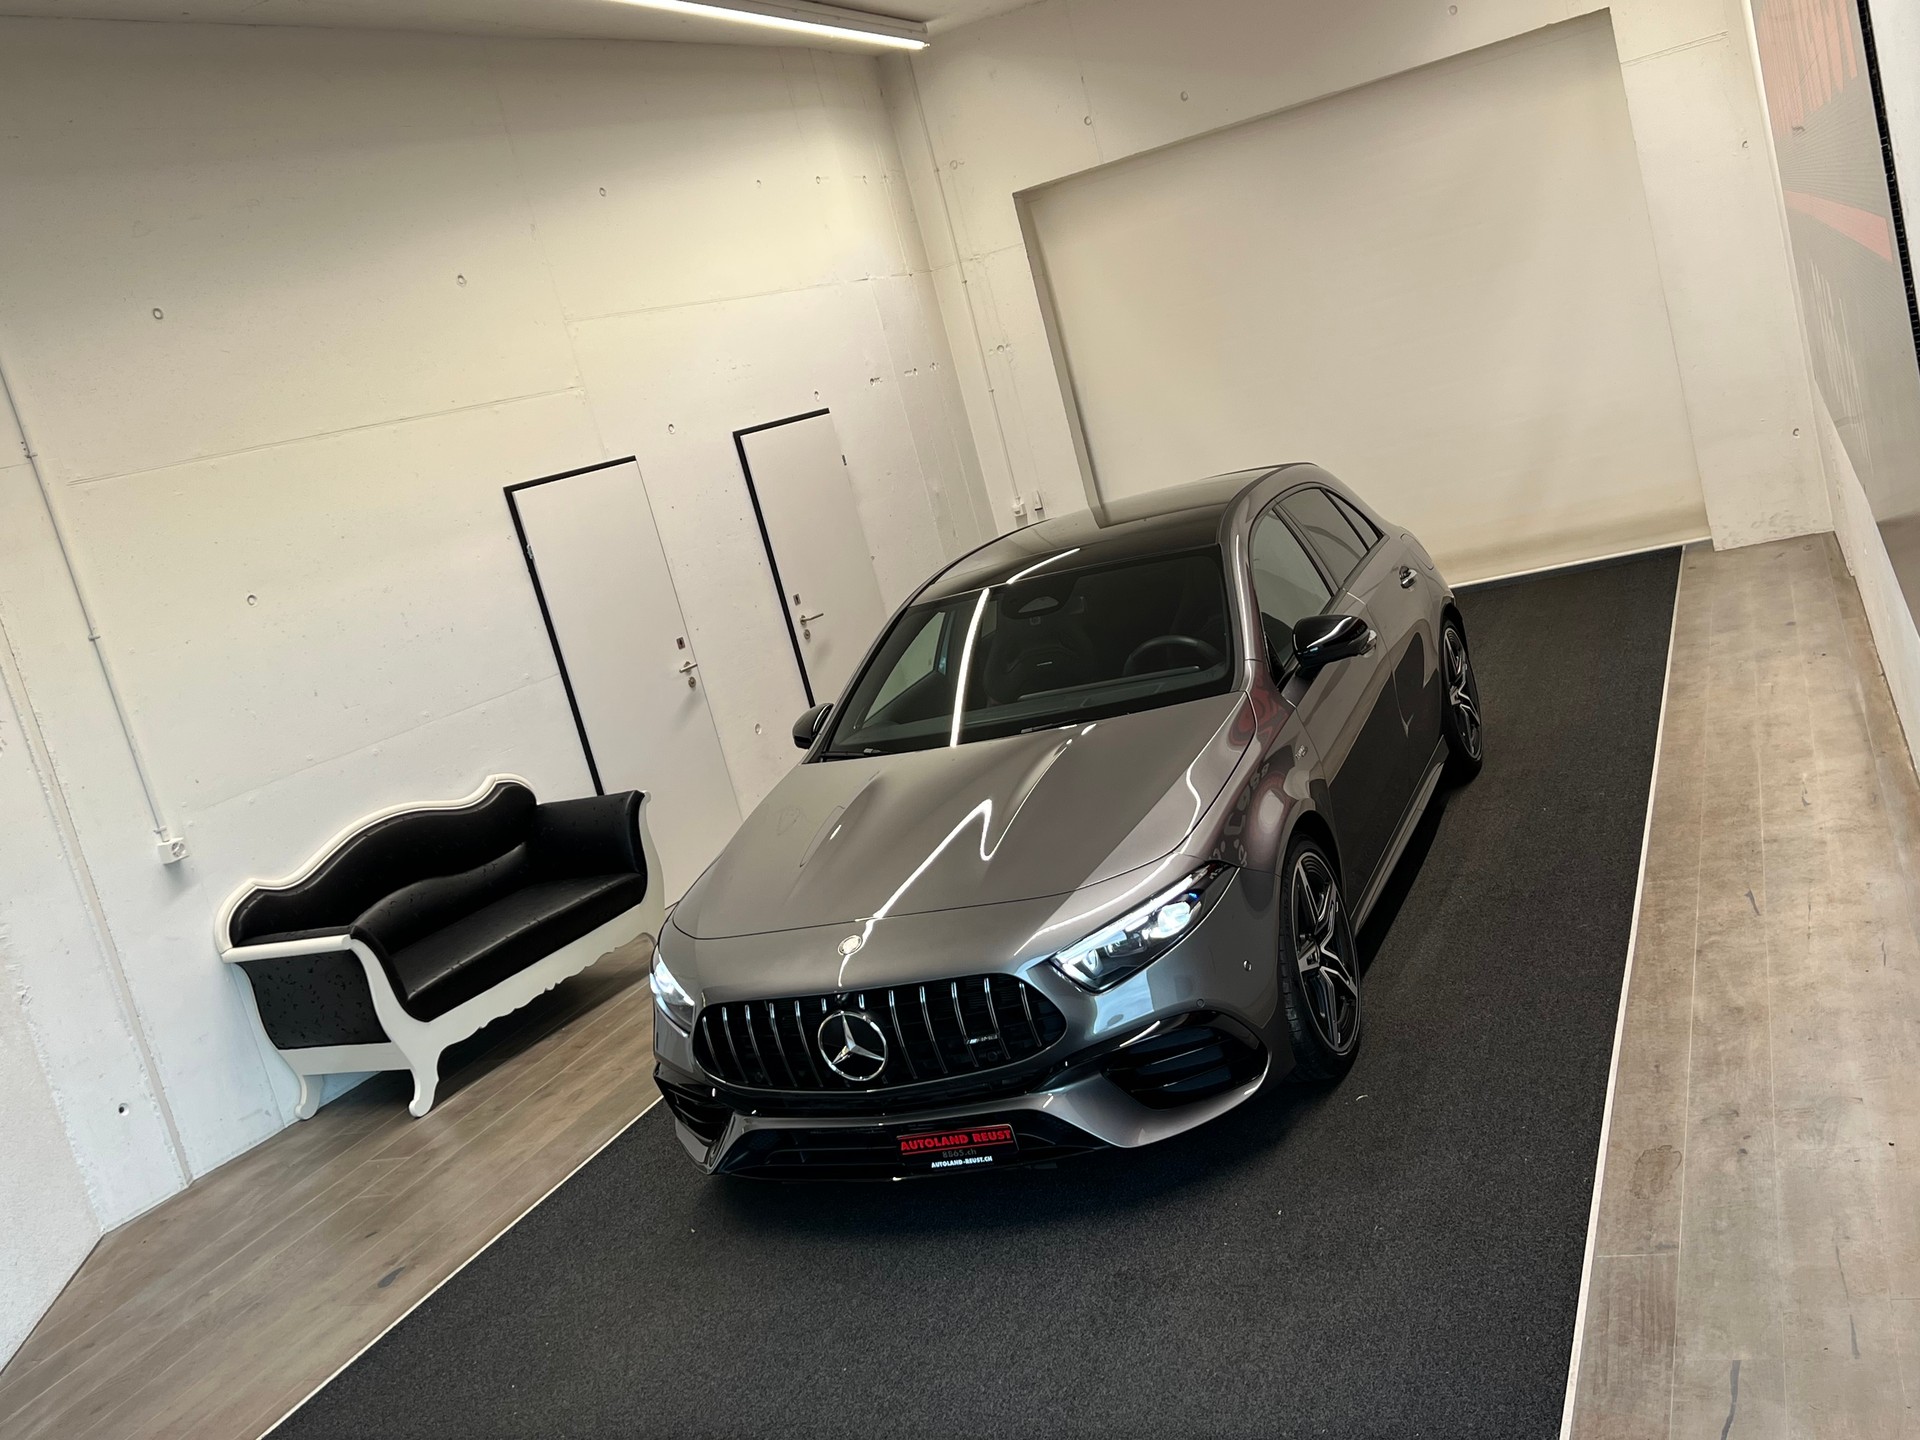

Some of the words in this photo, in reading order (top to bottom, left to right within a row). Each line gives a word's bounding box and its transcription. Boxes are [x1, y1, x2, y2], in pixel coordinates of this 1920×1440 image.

[900, 1134, 969, 1151] AUTOLAND
[972, 1130, 1011, 1143] REUST
[931, 1155, 993, 1169] AUTOLAND-REUST.CH
